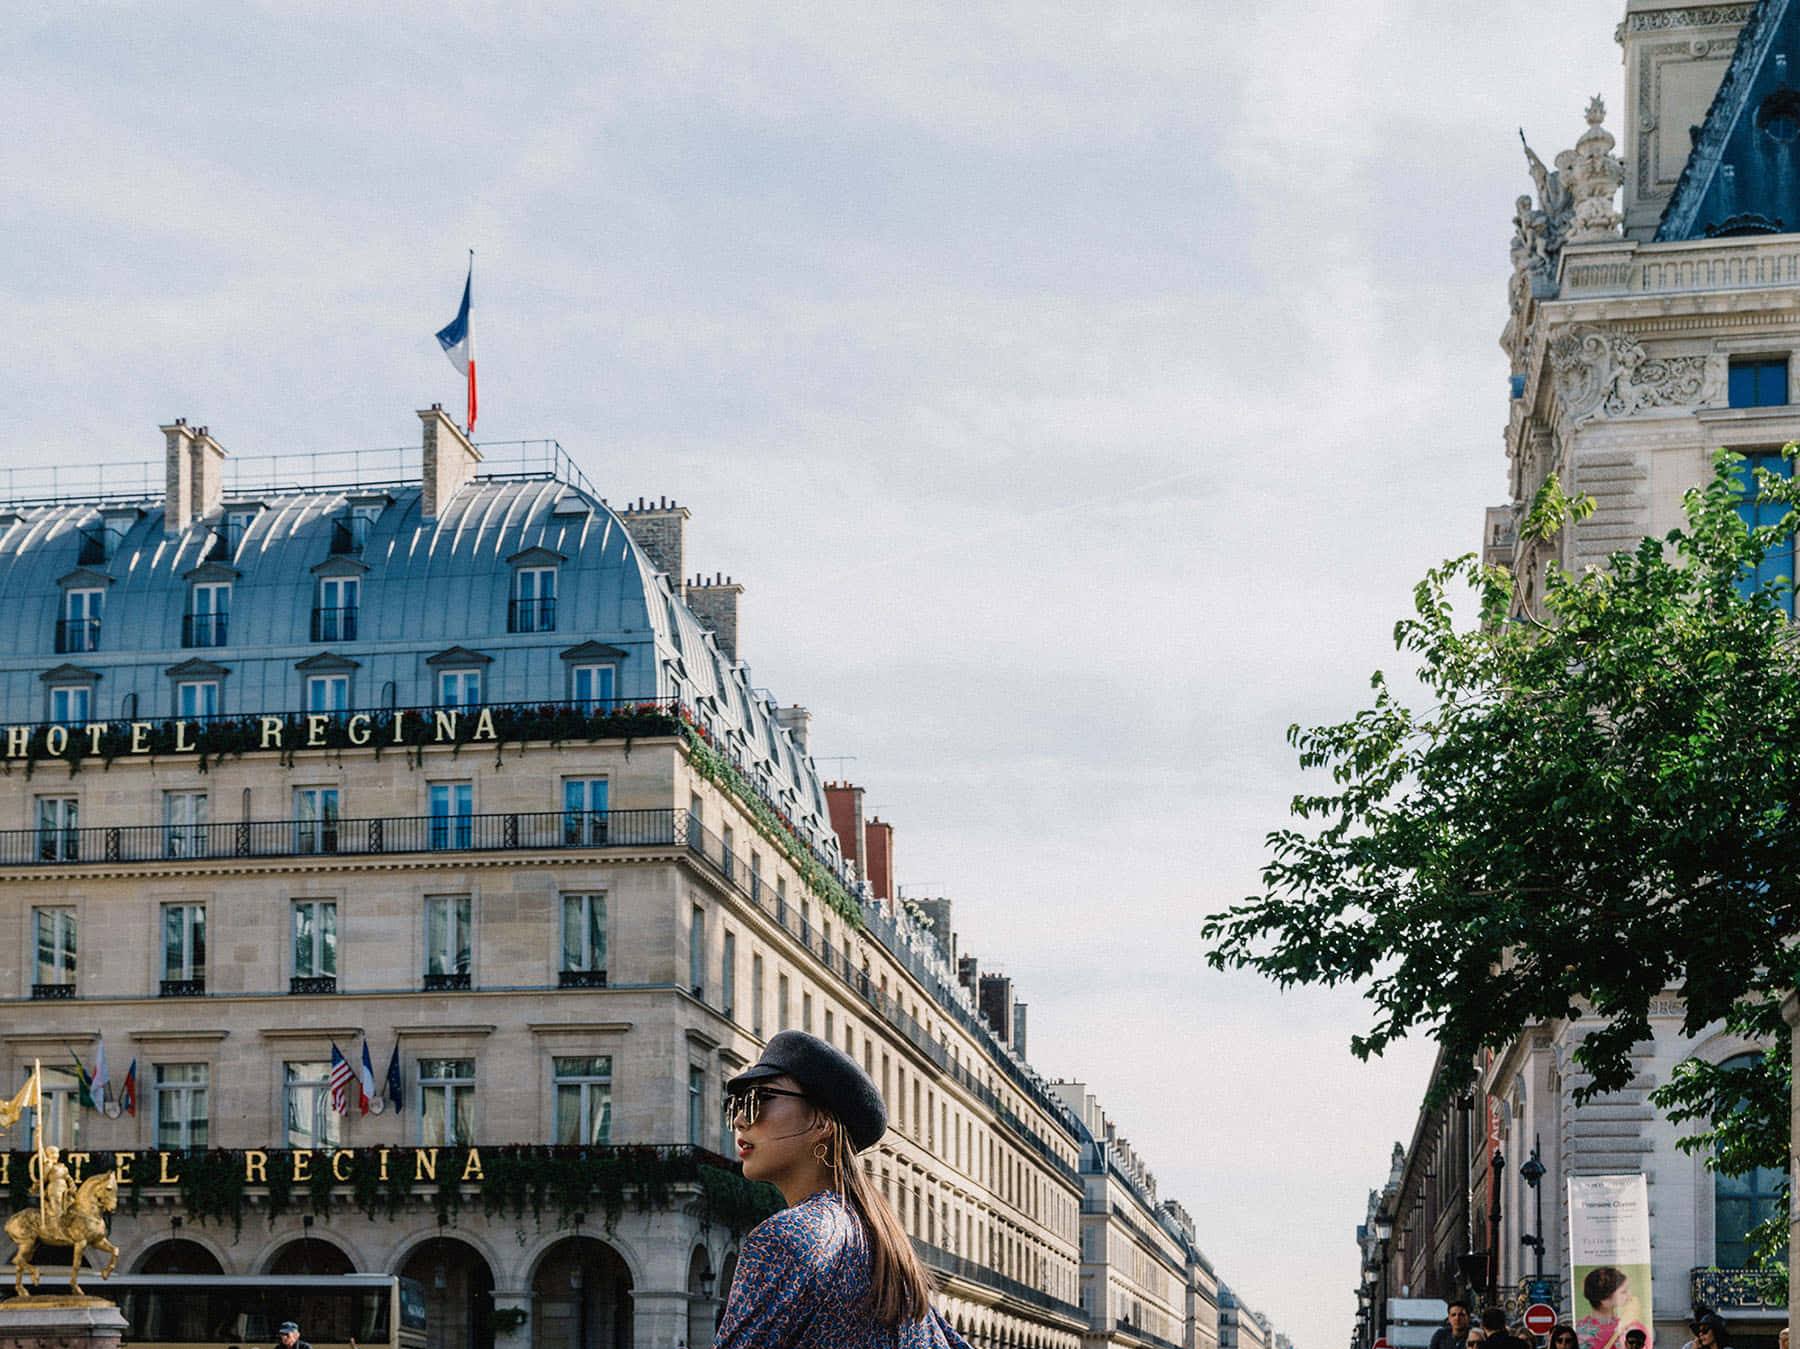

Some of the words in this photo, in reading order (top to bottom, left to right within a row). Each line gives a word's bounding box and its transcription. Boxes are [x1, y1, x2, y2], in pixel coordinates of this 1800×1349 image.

[6, 721, 197, 758] HOTEL
[259, 707, 498, 749] REGINA
[243, 1148, 486, 1183] REGINA
